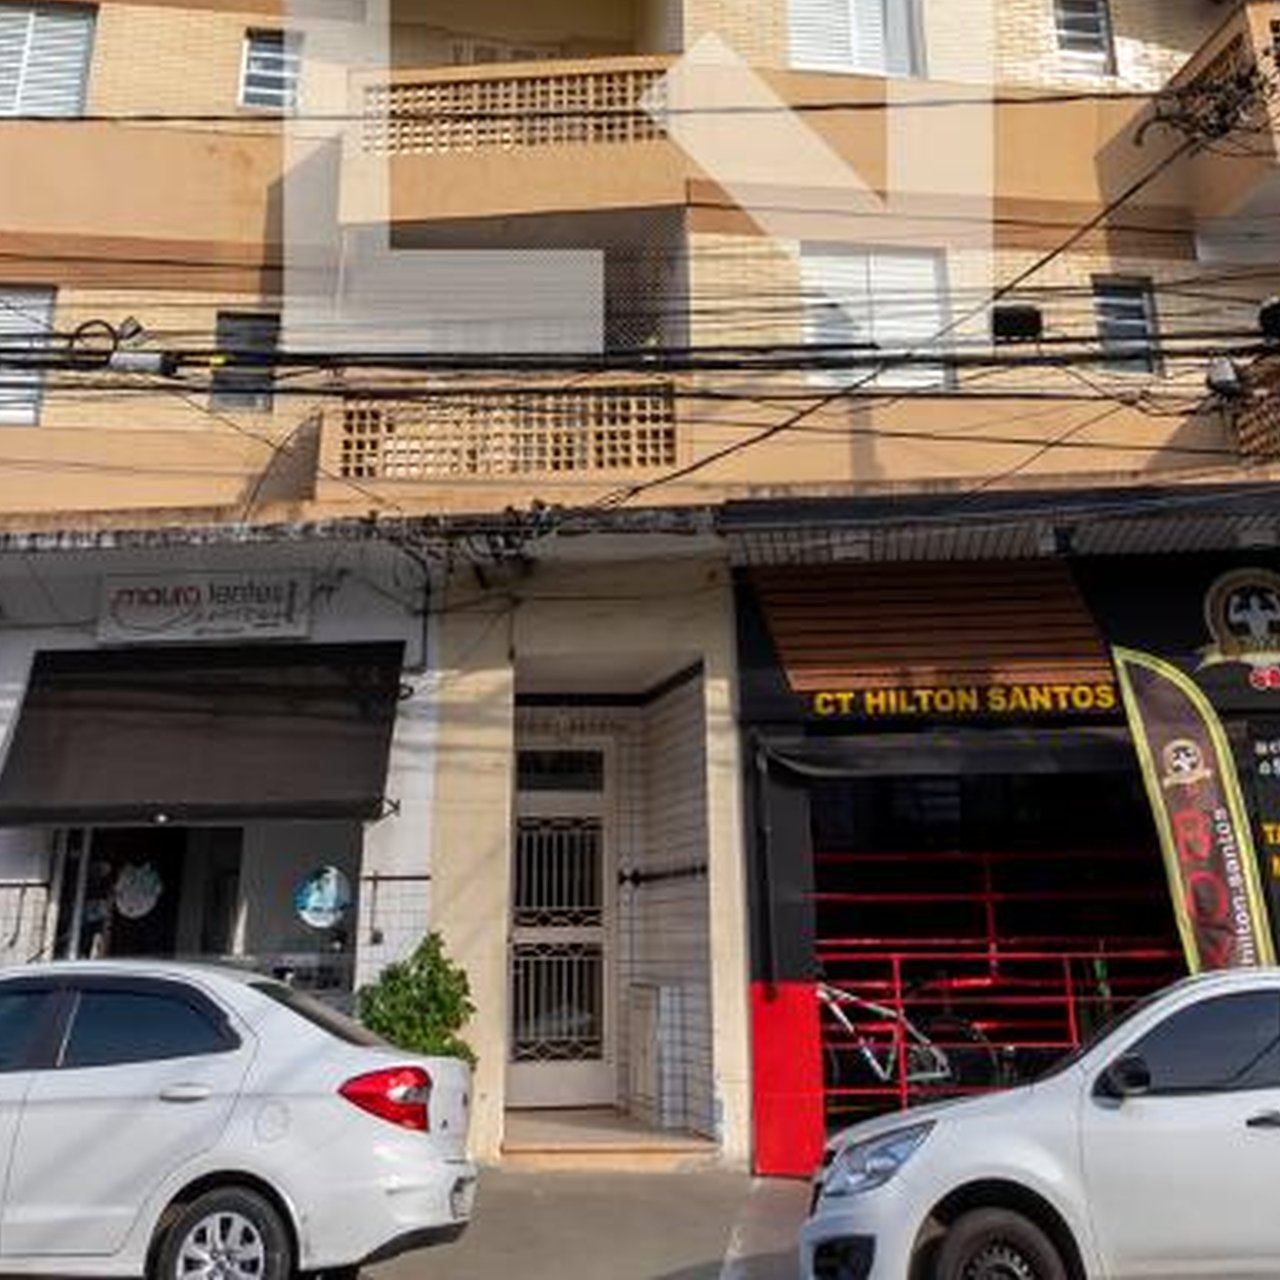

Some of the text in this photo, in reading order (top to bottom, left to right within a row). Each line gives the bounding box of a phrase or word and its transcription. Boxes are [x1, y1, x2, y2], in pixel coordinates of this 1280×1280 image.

[815, 685, 1115, 714] CT HILTON SANTOS
